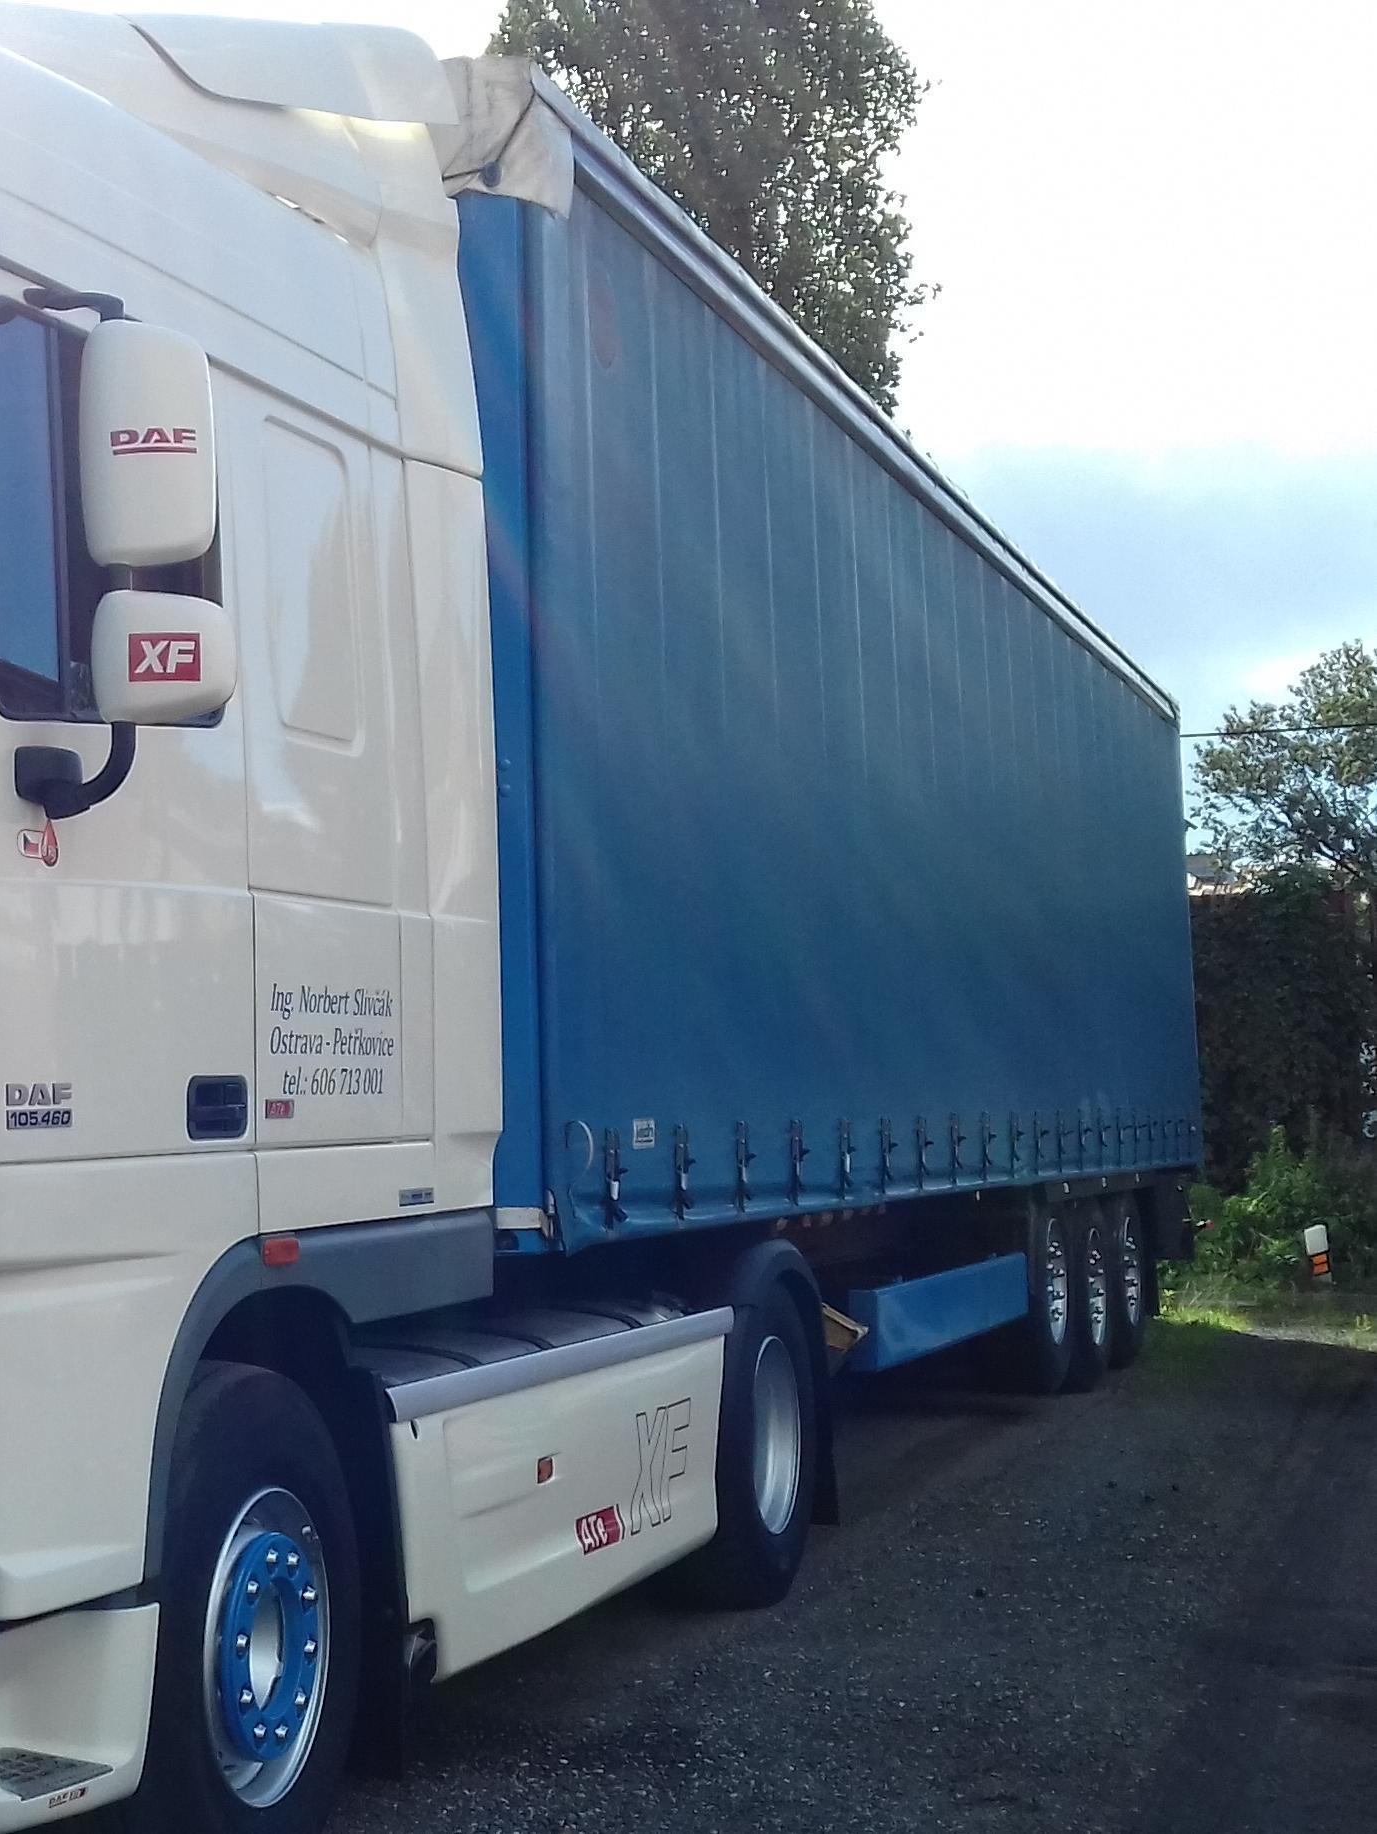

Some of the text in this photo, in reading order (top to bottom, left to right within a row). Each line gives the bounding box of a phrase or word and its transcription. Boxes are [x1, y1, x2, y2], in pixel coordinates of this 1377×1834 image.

[110, 427, 197, 447] DAF
[134, 640, 195, 674] XF
[299, 985, 350, 1014] Norbert
[353, 988, 392, 1017] Slivčák
[270, 1026, 322, 1055] Ostrava
[333, 1027, 394, 1057] Petřkovice
[6, 1083, 72, 1106] DAF
[311, 1067, 336, 1095] 606
[339, 1068, 361, 1095] 713
[363, 1068, 383, 1095] 001
[631, 1397, 691, 1536] XF
[582, 1514, 607, 1552] ATe
